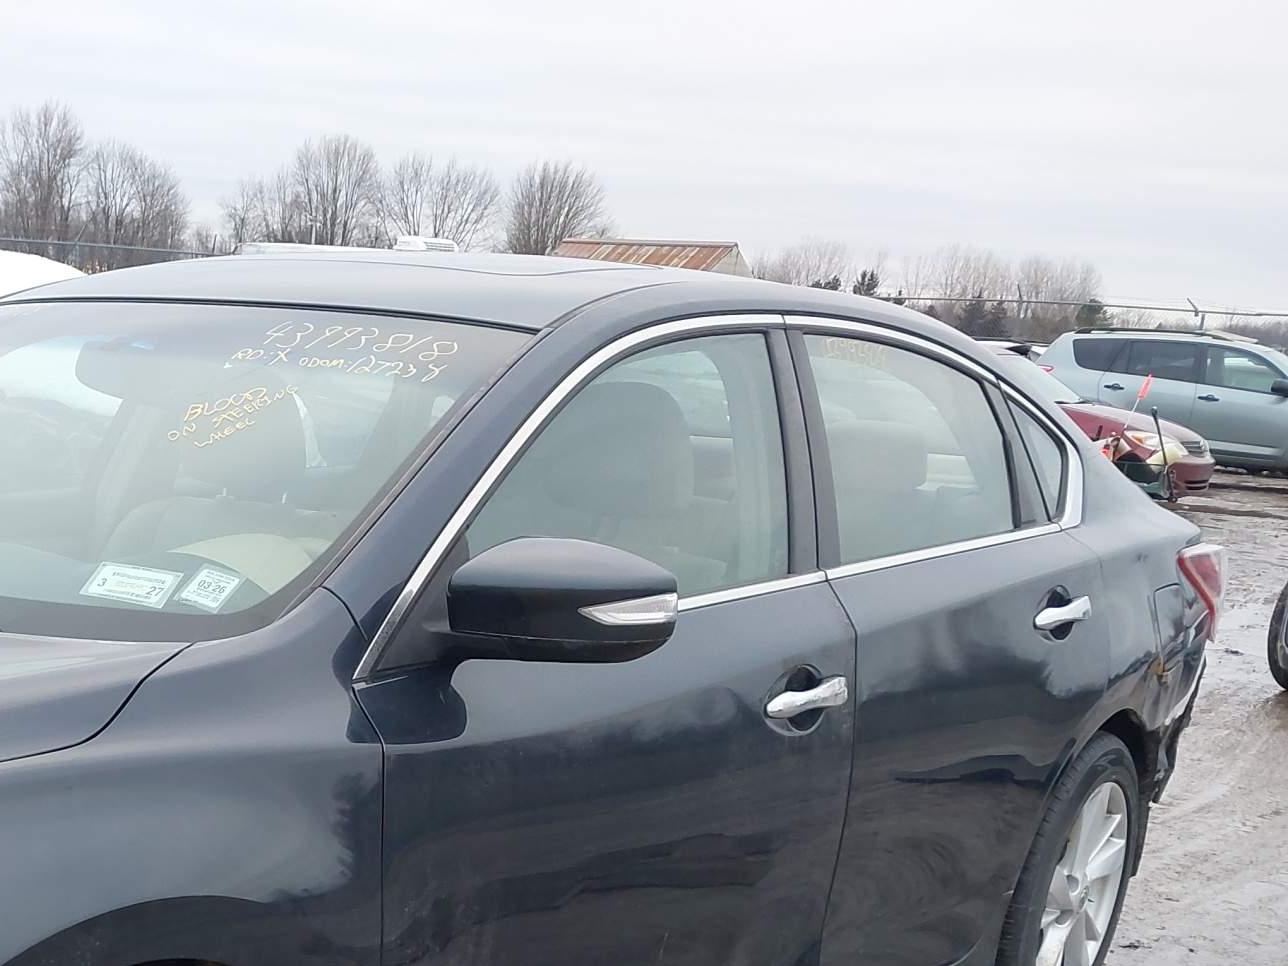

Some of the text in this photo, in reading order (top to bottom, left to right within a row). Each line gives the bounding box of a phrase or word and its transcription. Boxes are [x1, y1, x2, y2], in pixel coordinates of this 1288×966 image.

[264, 321, 459, 361] 43993818
[184, 387, 267, 421] BLOOD
[167, 422, 197, 441] ON
[193, 418, 256, 447] WHEEL
[96, 577, 108, 587] 3
[145, 585, 165, 597] 27
[197, 579, 227, 594] 03 26
